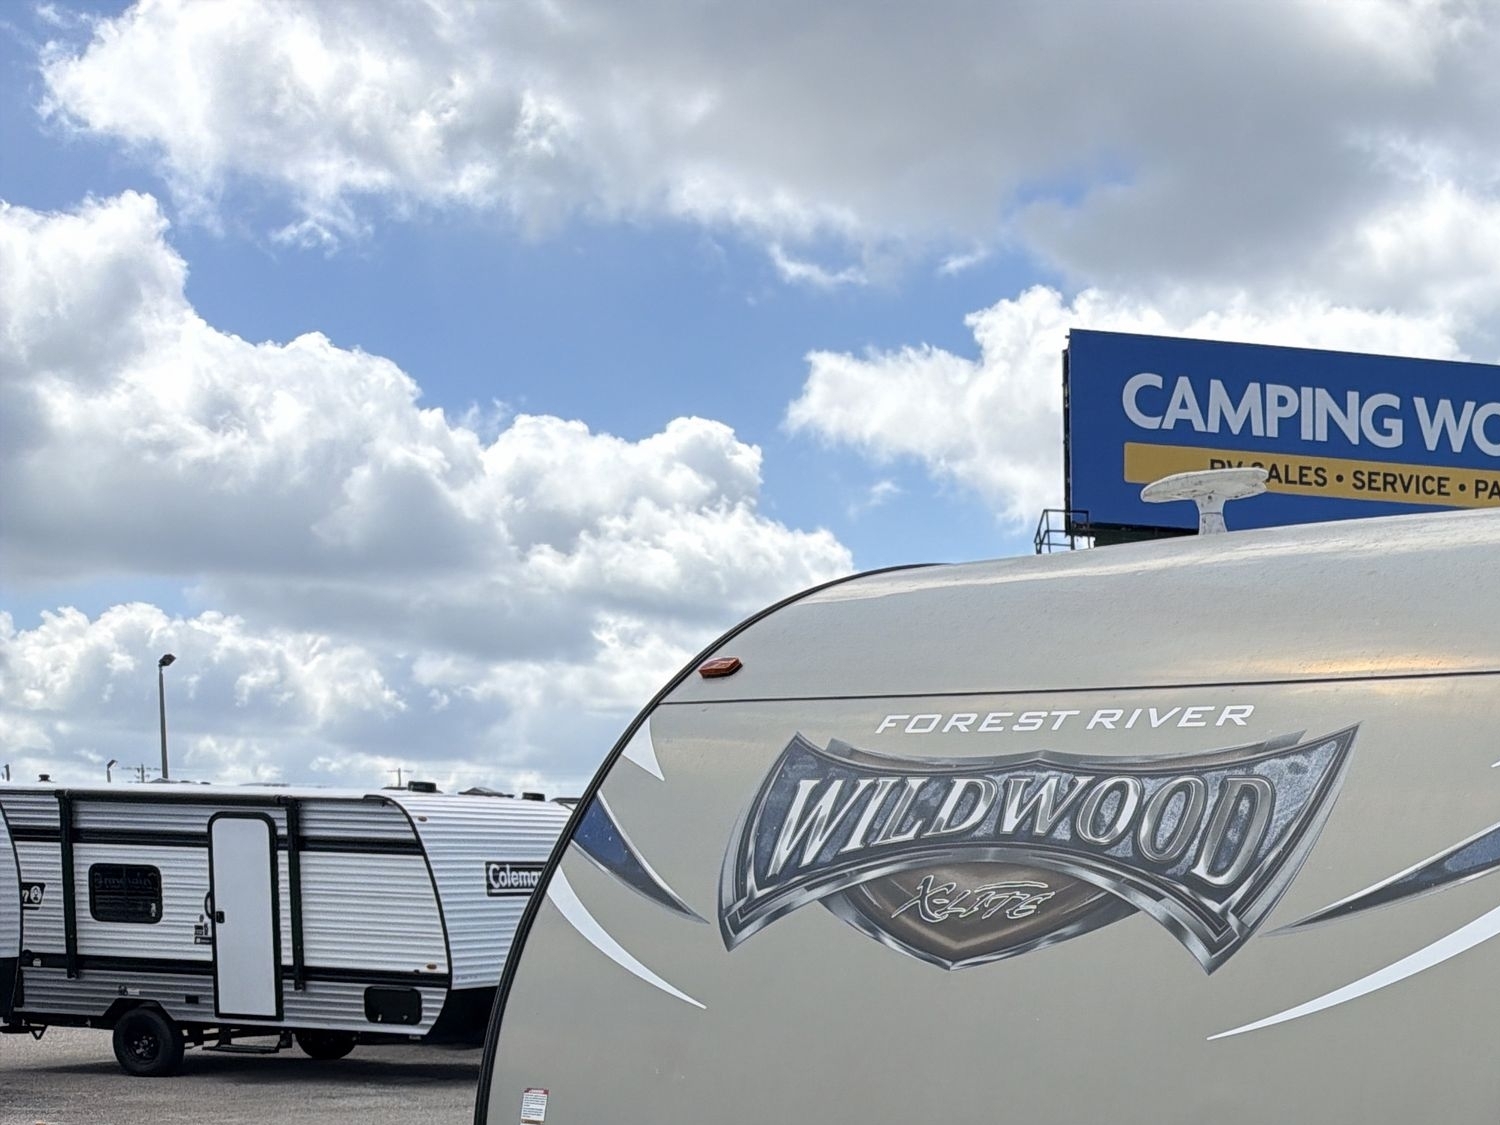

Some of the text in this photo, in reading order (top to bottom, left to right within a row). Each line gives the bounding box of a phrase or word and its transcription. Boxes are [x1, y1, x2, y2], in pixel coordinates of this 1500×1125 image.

[1121, 373, 1402, 448] CAMPING
[1252, 462, 1328, 487] ALES
[1352, 470, 1452, 497] SERVICE
[875, 704, 1255, 734] FOREST RIVER
[767, 774, 1276, 887] WILDWOOD
[489, 864, 542, 888] Colema
